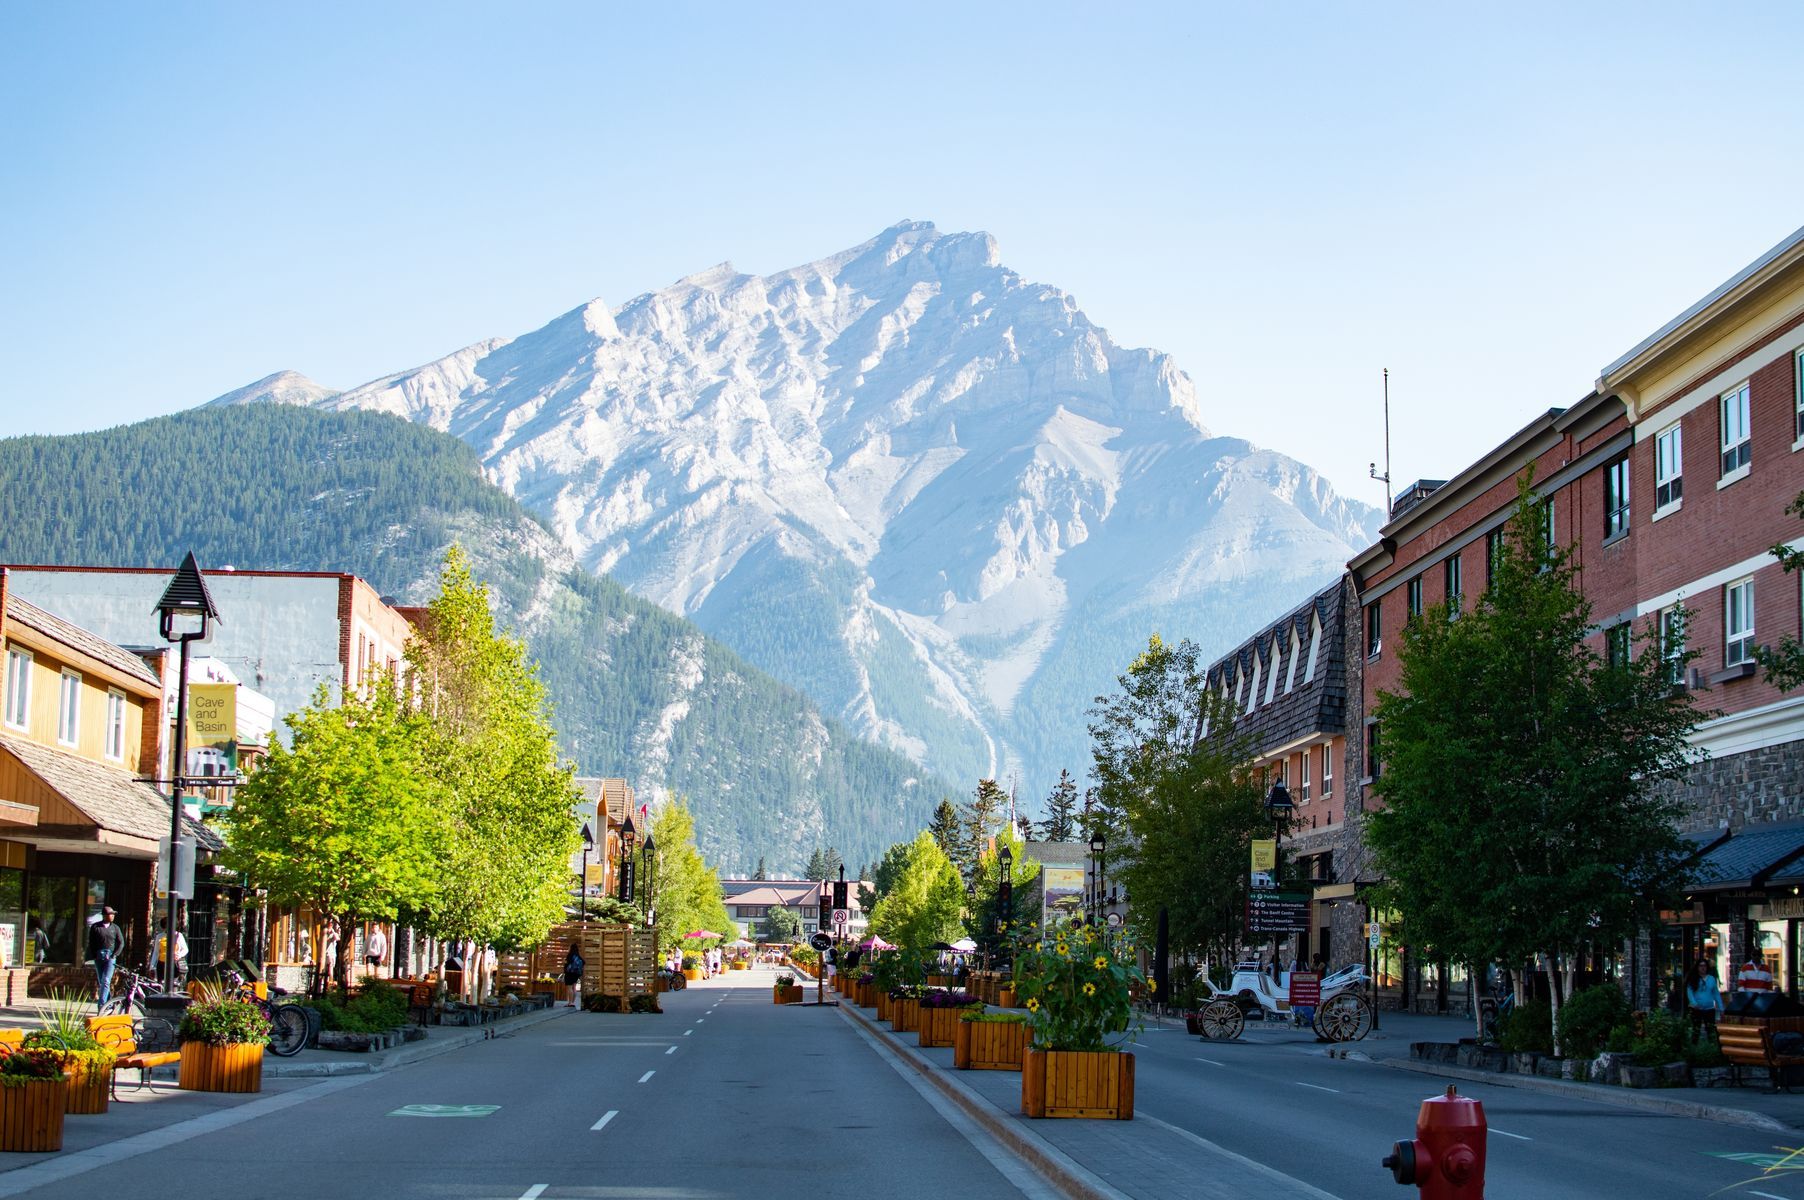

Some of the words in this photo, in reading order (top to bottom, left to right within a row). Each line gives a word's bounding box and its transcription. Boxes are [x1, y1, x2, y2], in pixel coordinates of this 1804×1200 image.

[196, 696, 225, 708] Cave
[195, 708, 217, 719] and
[196, 721, 227, 732] Basin
